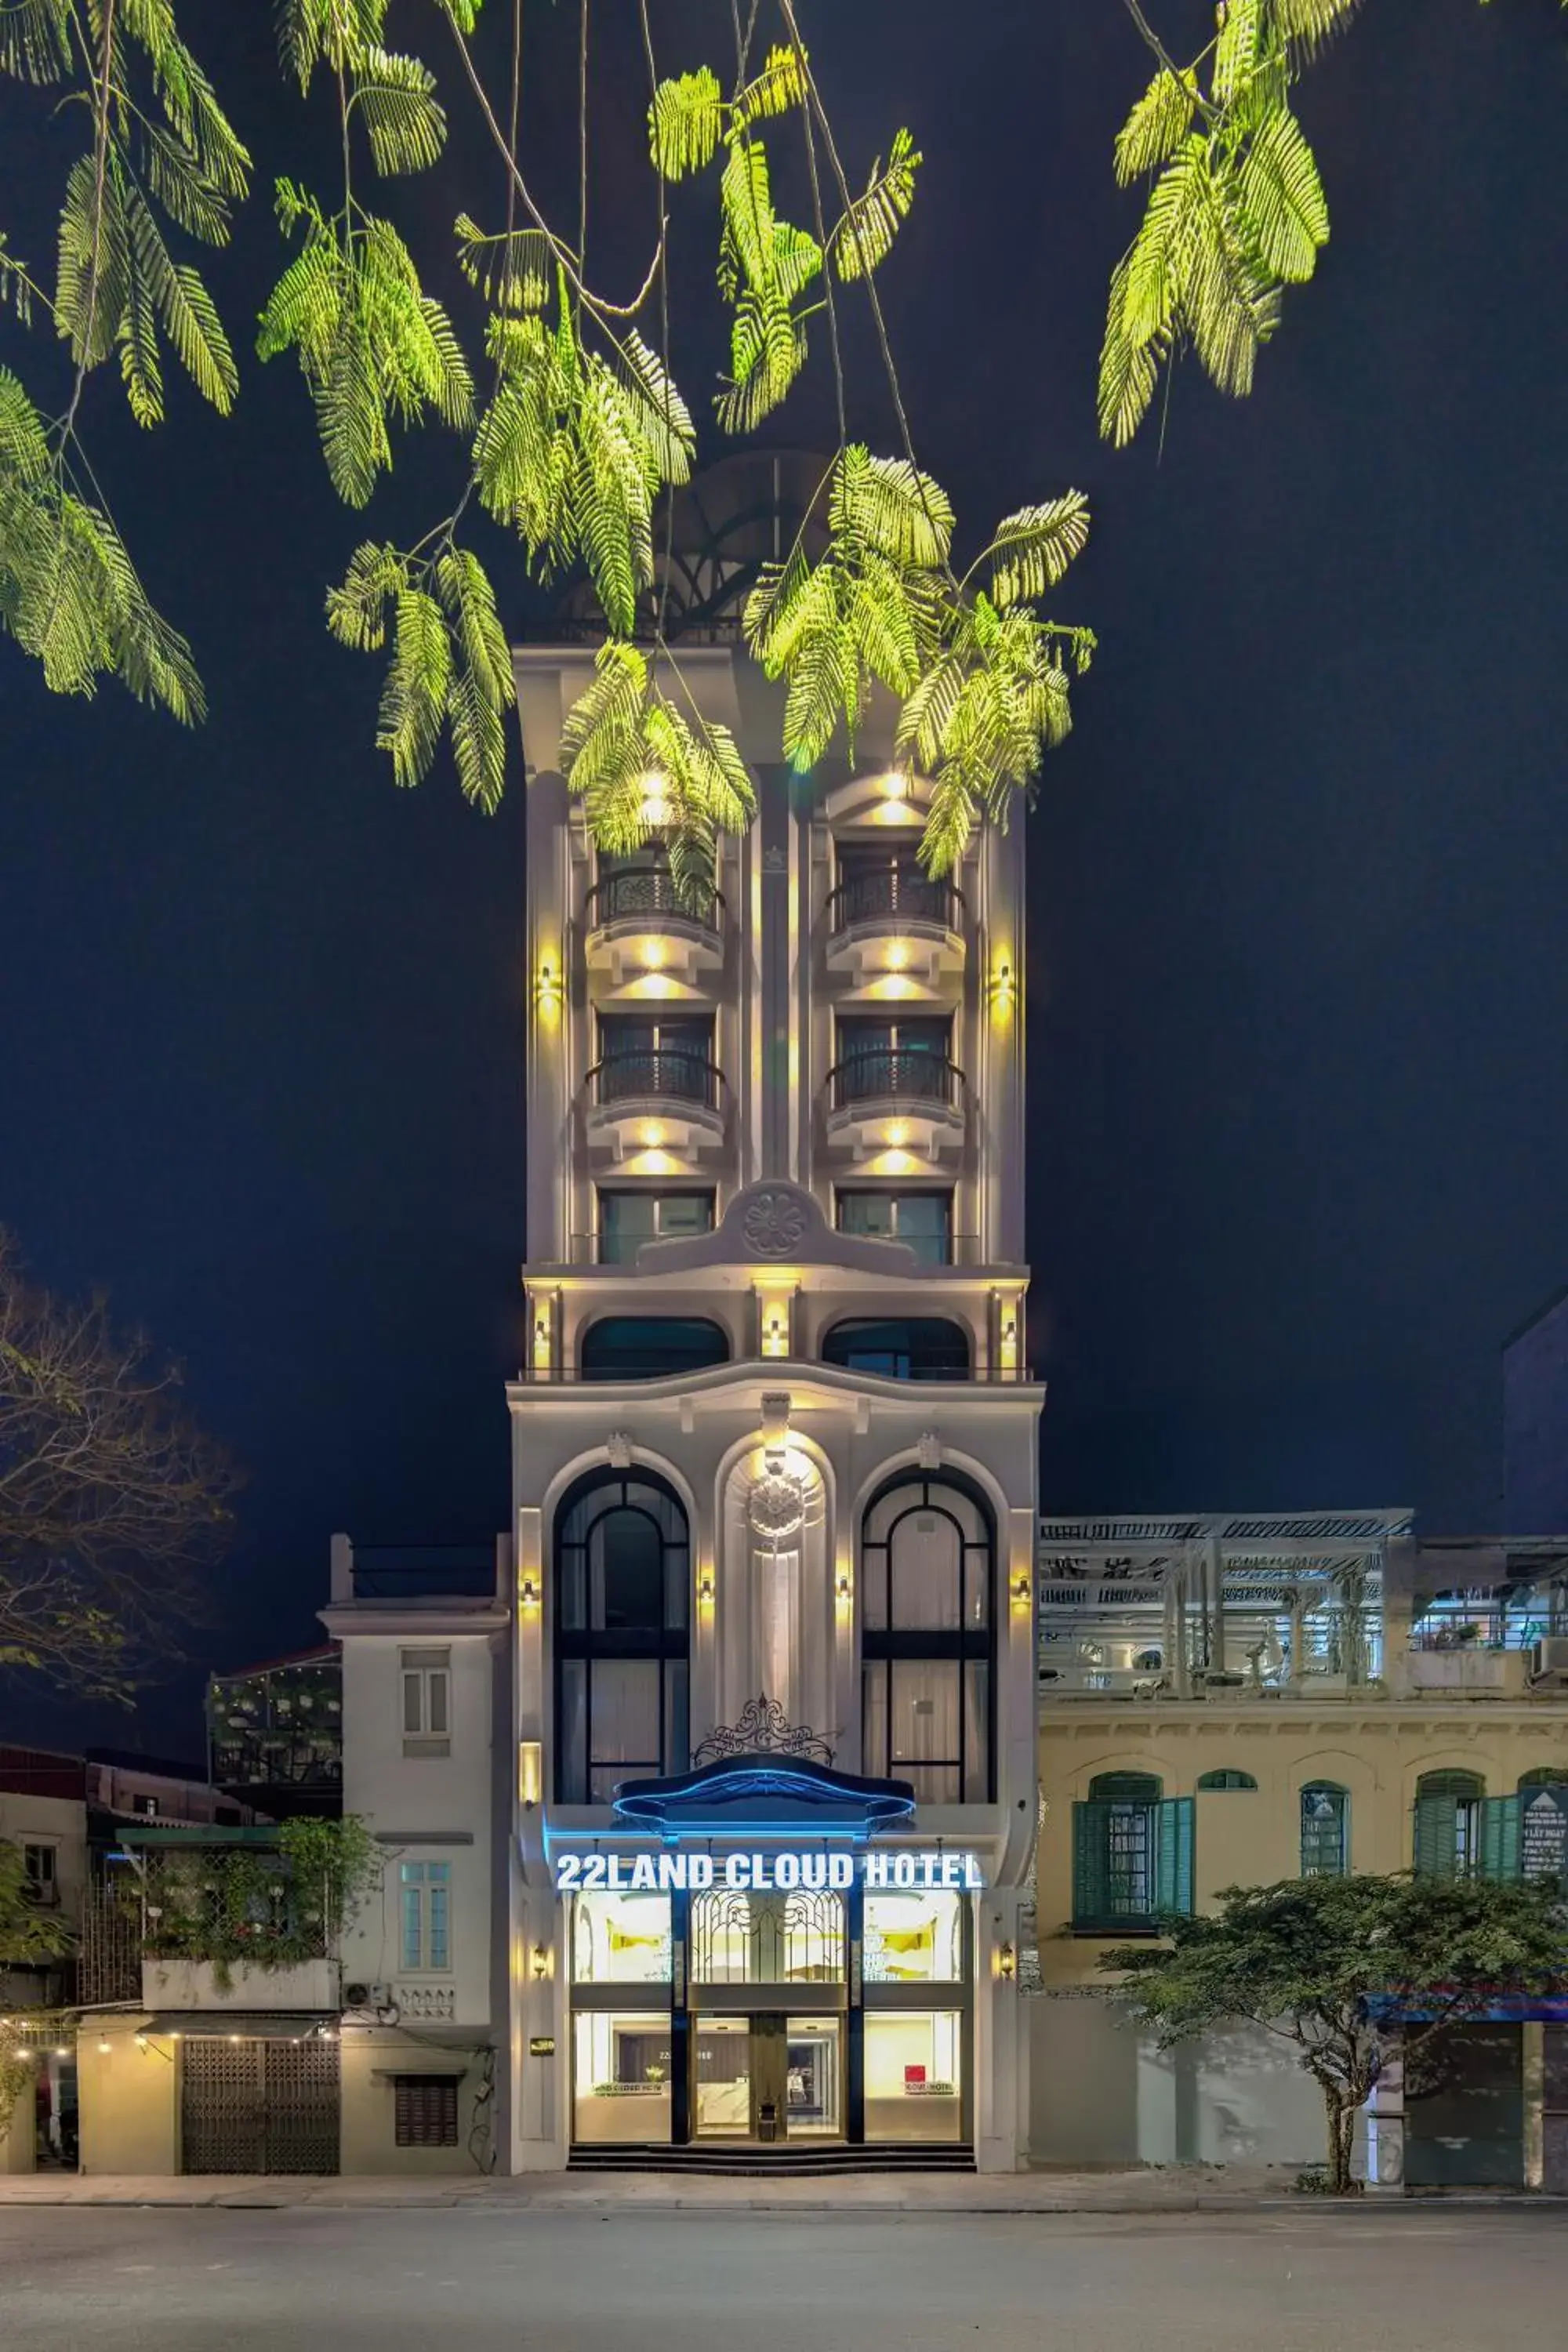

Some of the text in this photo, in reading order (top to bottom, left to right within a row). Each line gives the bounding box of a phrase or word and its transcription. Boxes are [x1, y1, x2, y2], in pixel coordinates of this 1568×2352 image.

[557, 1853, 982, 1889] 22LAND CLOUD HOTEL
